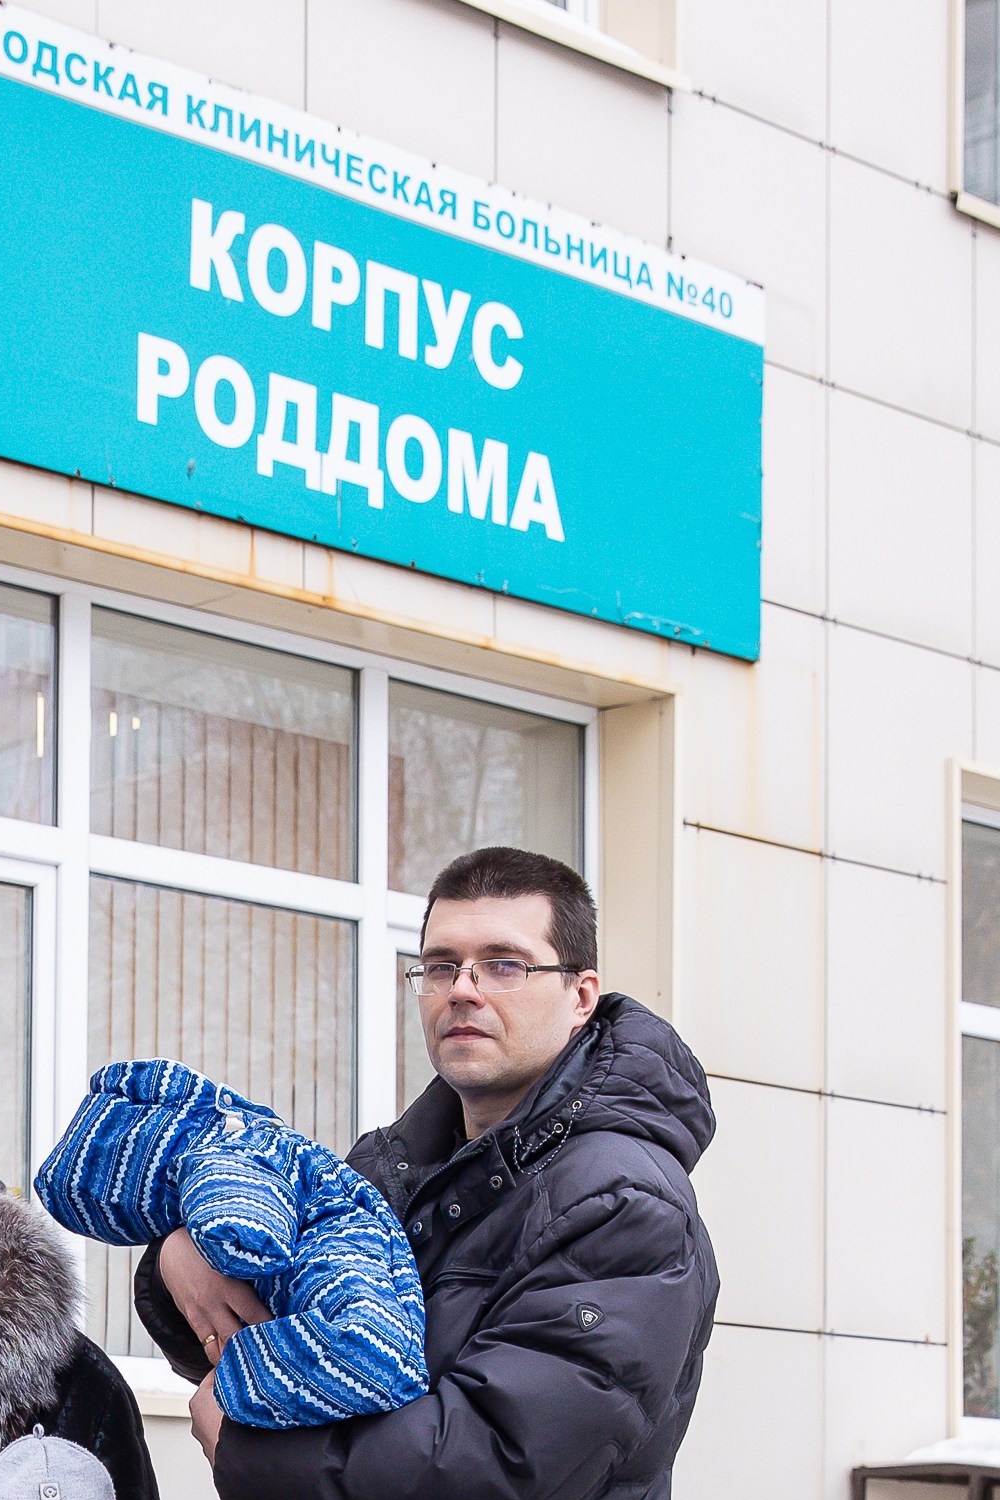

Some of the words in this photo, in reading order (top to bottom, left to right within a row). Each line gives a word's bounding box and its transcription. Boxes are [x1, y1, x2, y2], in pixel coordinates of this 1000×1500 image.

[186, 94, 458, 220] КЛИНИЧЕСКАЯ
[472, 200, 653, 291] БОЛЬНИЦА
[666, 271, 733, 319] №40
[189, 197, 525, 391] КОРПУС
[136, 331, 566, 543] РОДДОМА
